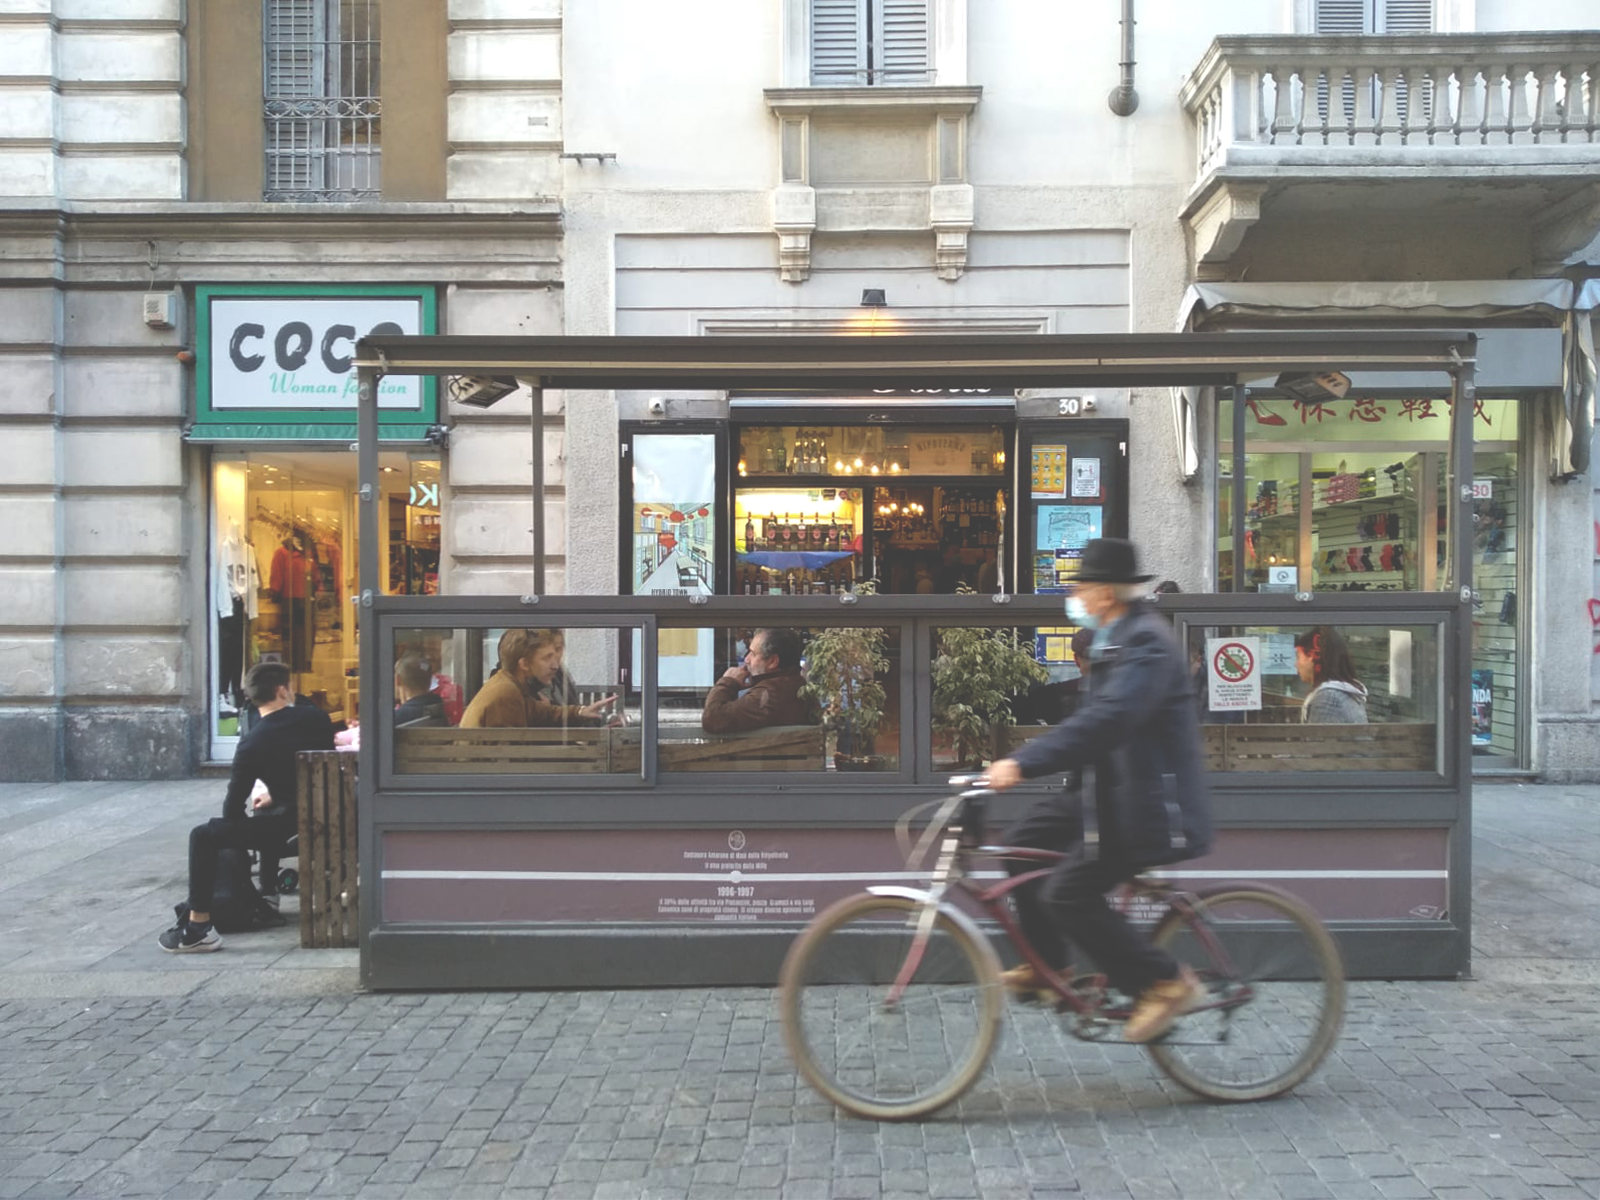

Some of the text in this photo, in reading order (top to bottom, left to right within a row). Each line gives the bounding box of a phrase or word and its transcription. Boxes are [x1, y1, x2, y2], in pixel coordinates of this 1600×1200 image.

[229, 321, 404, 374] COC
[269, 373, 407, 399] Woman faion
[1059, 398, 1079, 415] 30
[717, 886, 755, 896] 1996-1997
